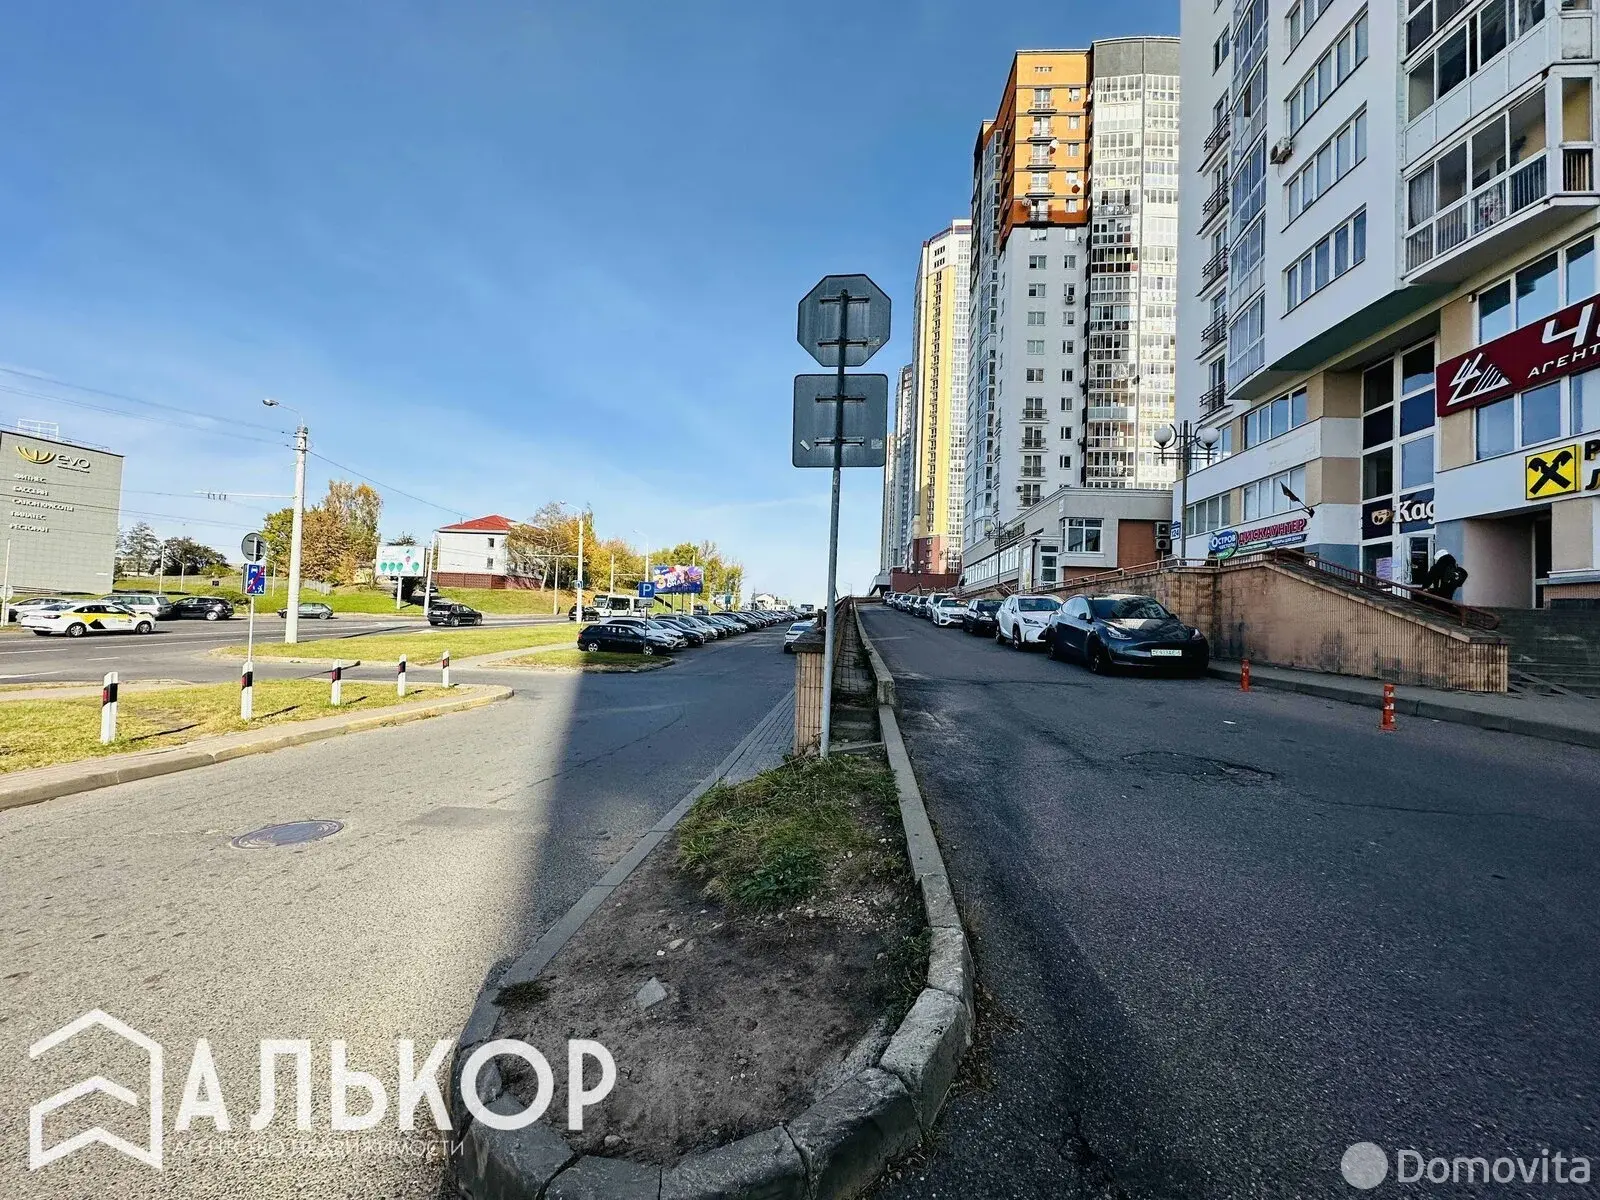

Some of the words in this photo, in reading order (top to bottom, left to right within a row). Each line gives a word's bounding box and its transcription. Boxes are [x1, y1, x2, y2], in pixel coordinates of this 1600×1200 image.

[56, 453, 91, 469] evo
[1171, 528, 1180, 538] 124
[1238, 518, 1306, 545] ДИСКАУНТЕР
[642, 584, 652, 596] P
